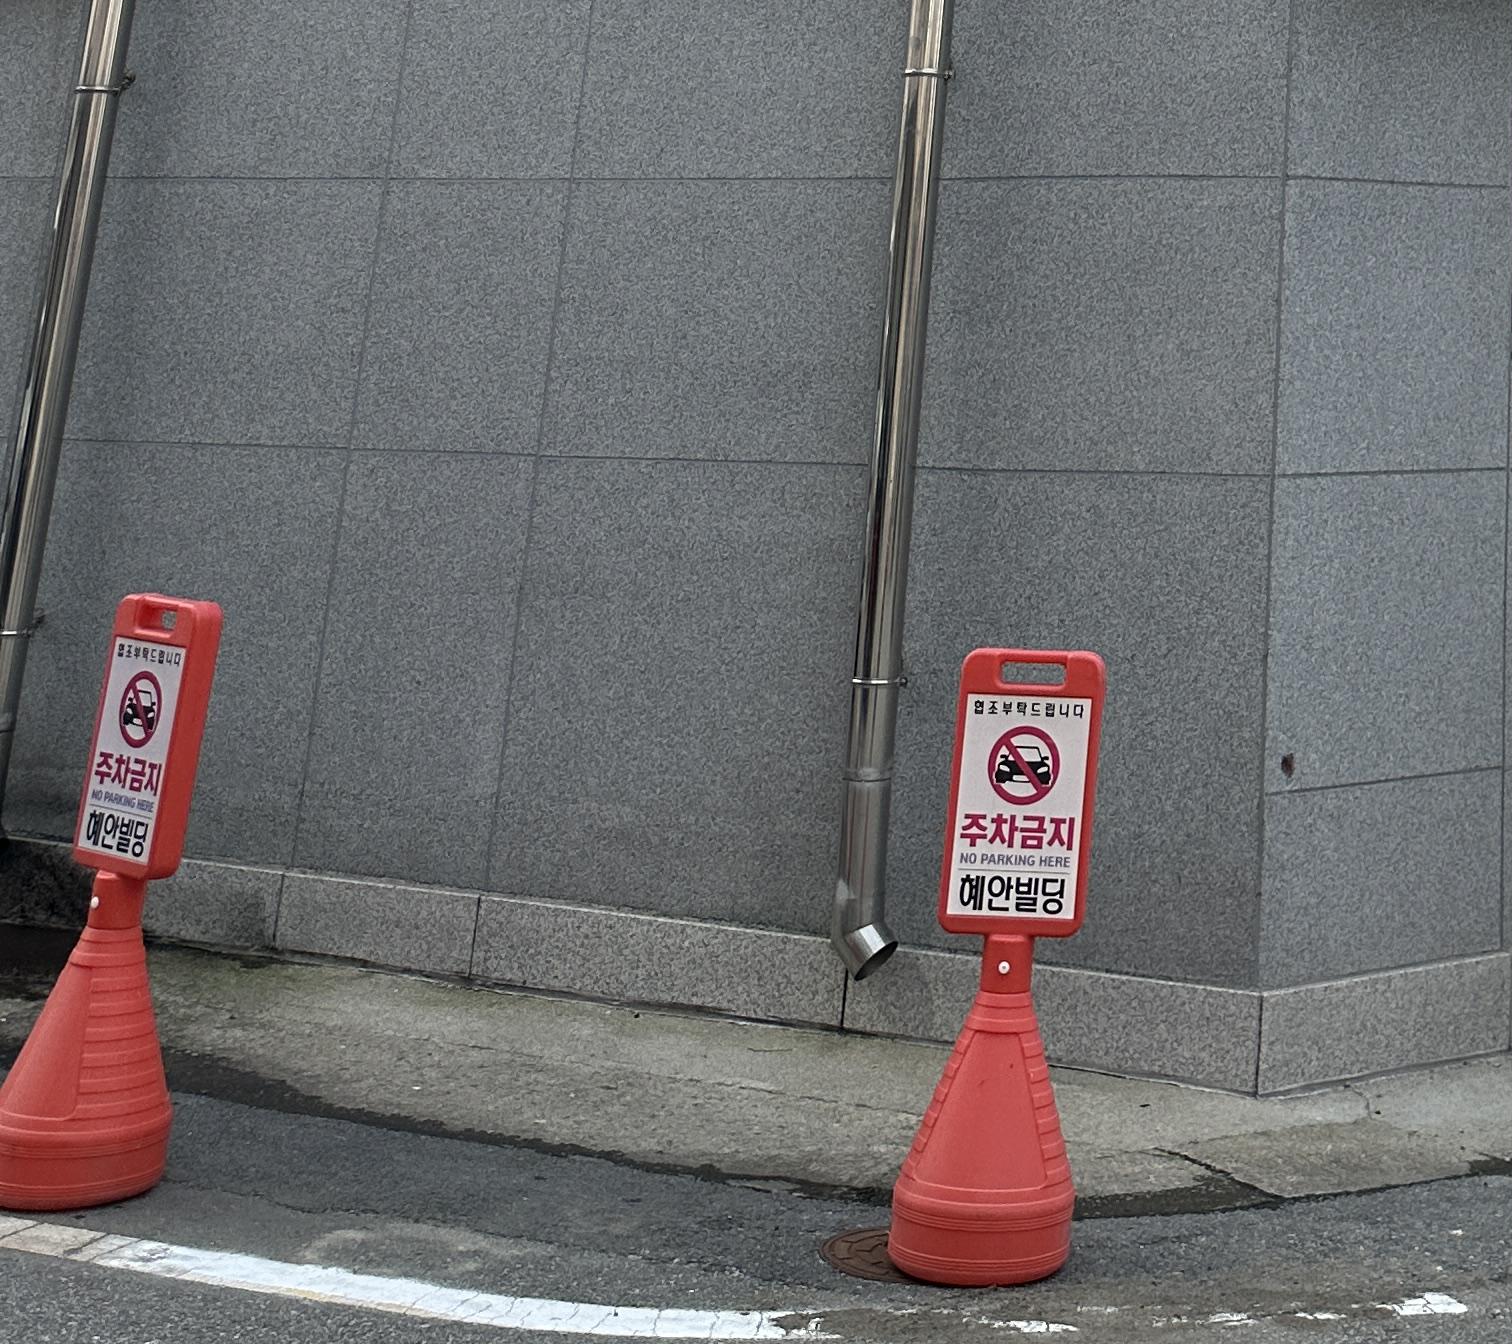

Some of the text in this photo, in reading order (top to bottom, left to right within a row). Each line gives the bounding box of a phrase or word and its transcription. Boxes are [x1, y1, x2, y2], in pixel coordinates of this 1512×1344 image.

[94, 751, 163, 797] 주차금지
[91, 788, 102, 801] NO
[104, 791, 136, 810] PARKING
[959, 812, 1076, 851] 주차금지
[960, 852, 1071, 868] NO PARKING HERE
[959, 874, 1066, 915] 혜안빌딩
